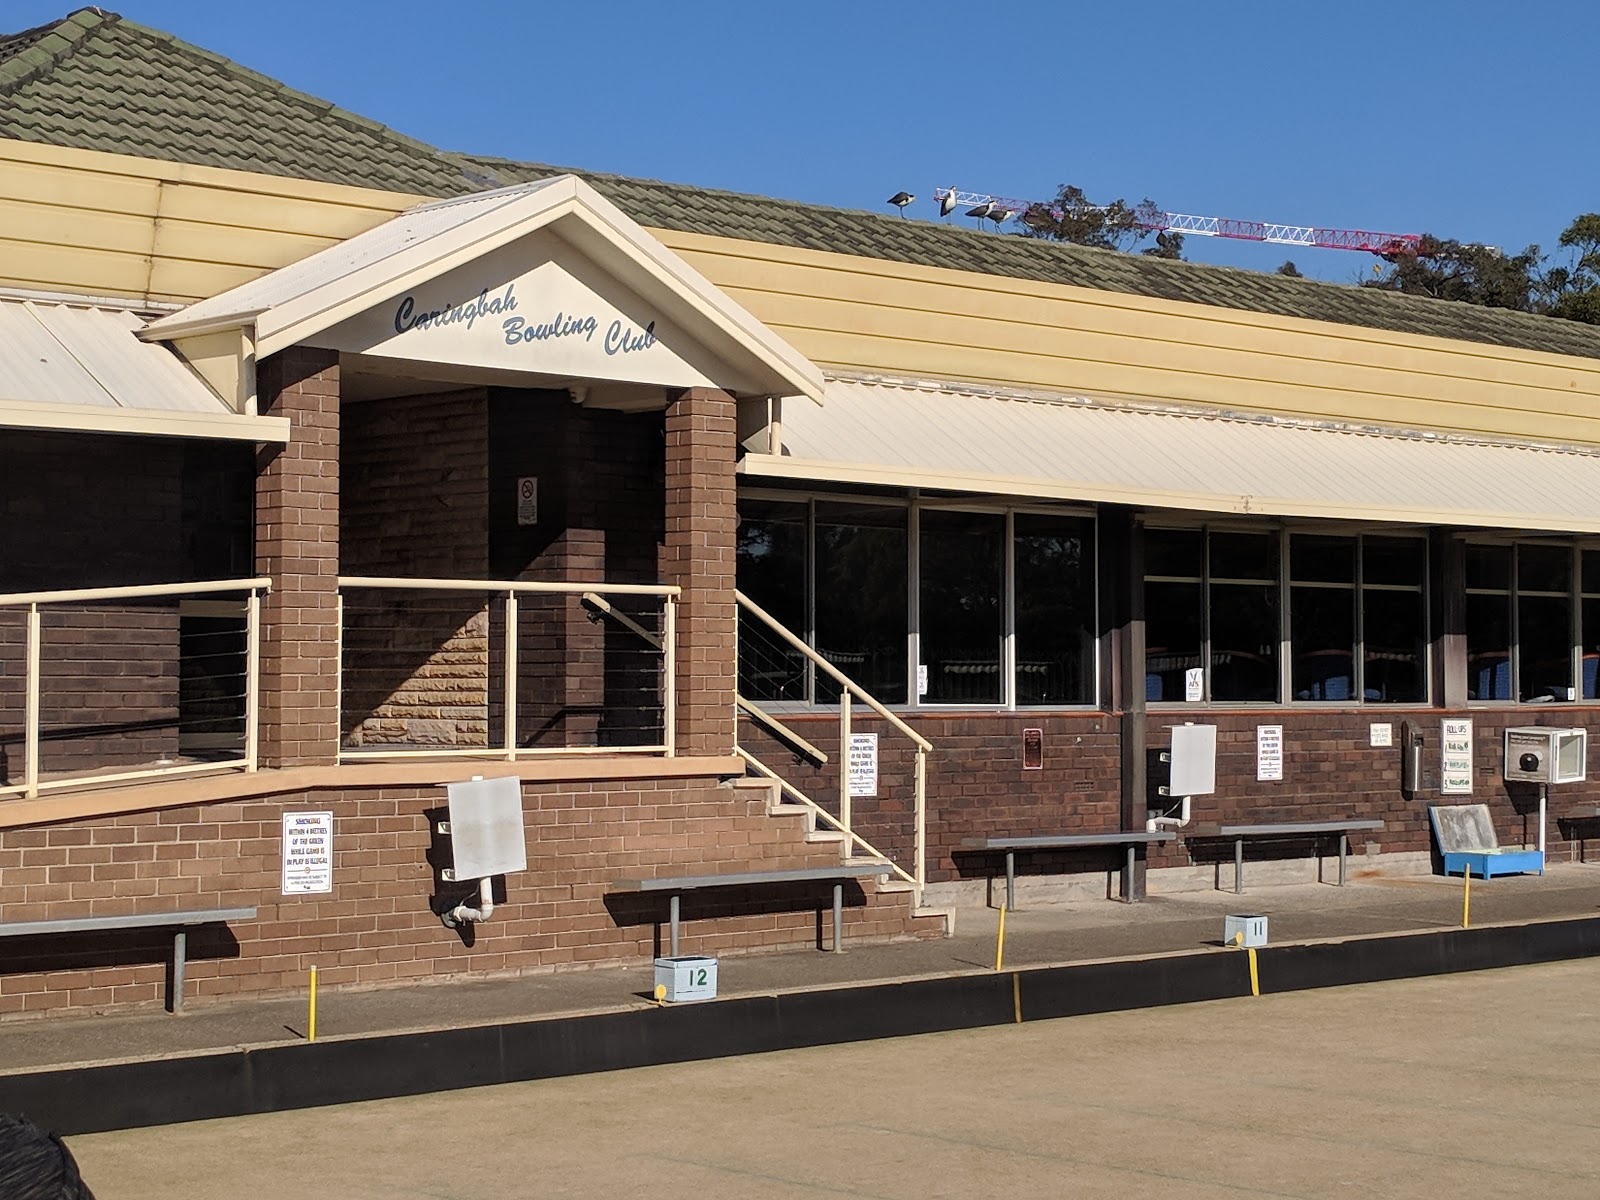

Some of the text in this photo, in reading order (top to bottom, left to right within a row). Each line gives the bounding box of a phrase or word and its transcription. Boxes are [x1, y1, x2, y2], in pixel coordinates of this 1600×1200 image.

[394, 283, 658, 356] Caringbah Bowling Club
[1254, 921, 1262, 936] 11
[690, 968, 707, 986] 12
